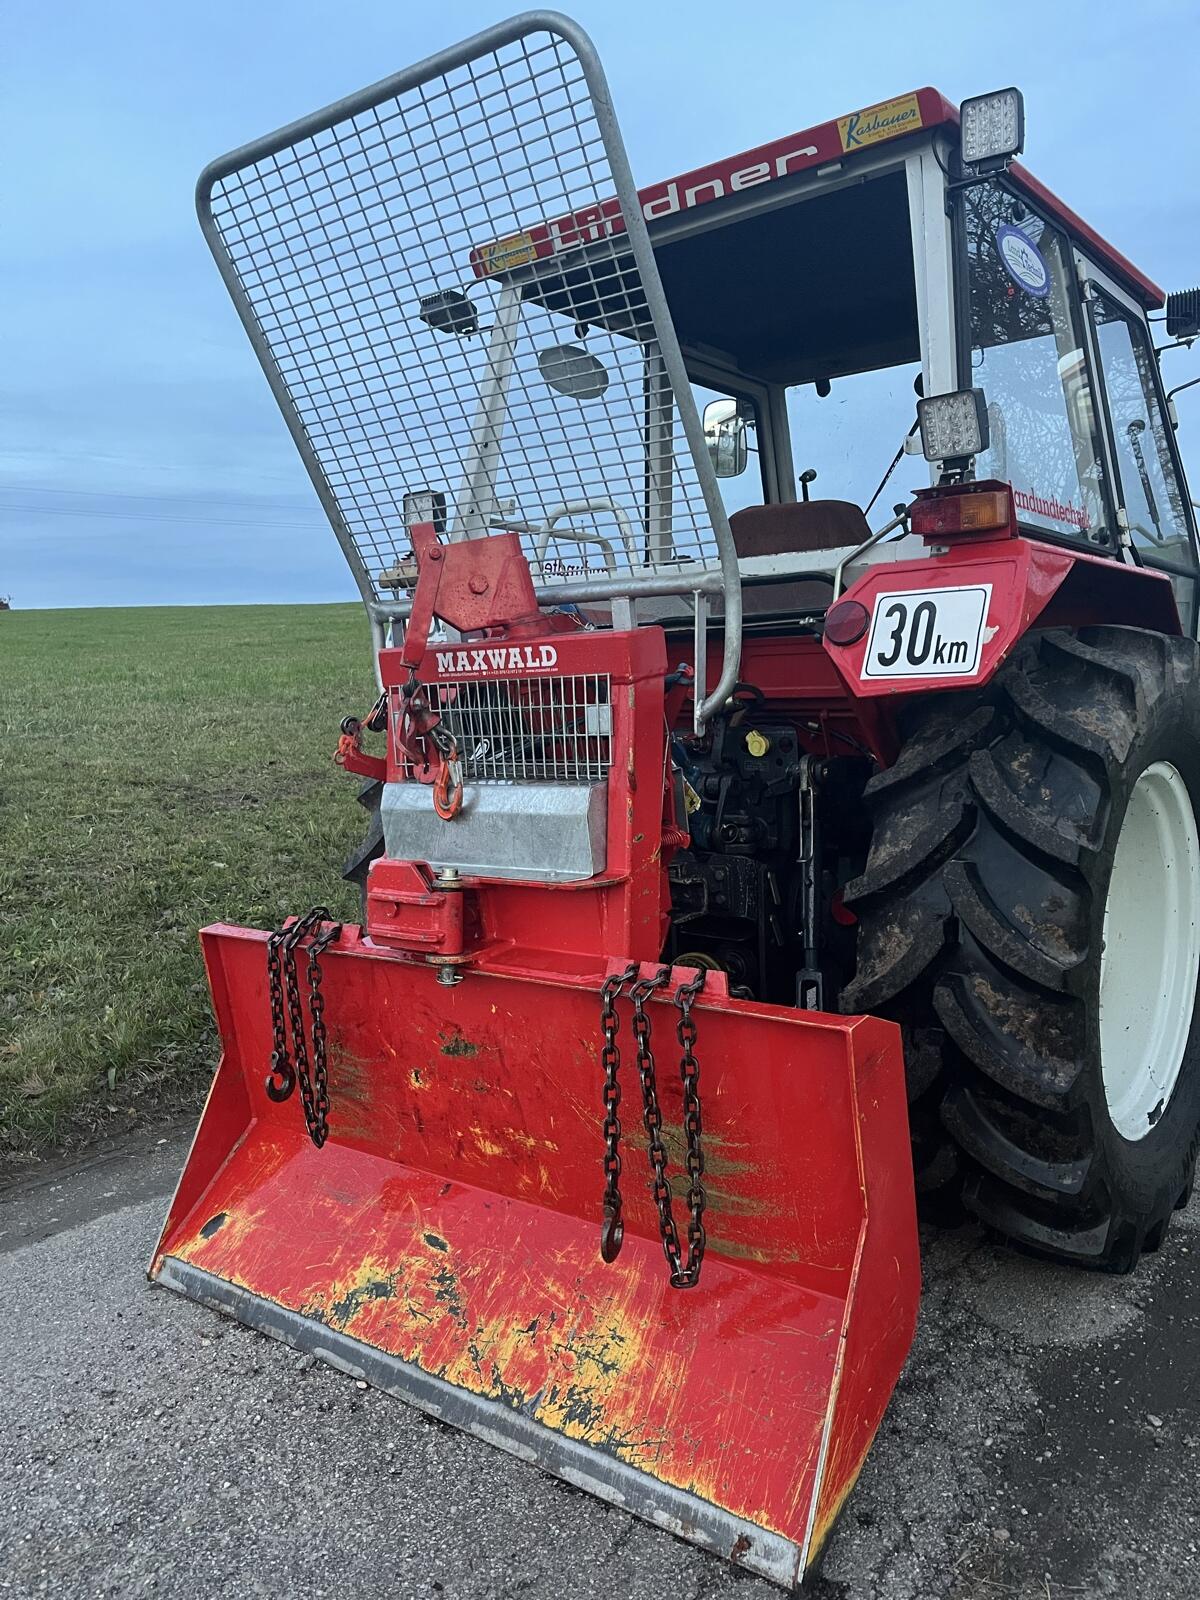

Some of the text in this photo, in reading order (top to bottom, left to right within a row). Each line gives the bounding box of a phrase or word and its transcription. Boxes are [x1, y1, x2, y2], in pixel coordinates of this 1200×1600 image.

[1009, 480, 1092, 529] andundtechnik
[877, 600, 969, 667] 30 km
[436, 645, 558, 672] MAXWALD
